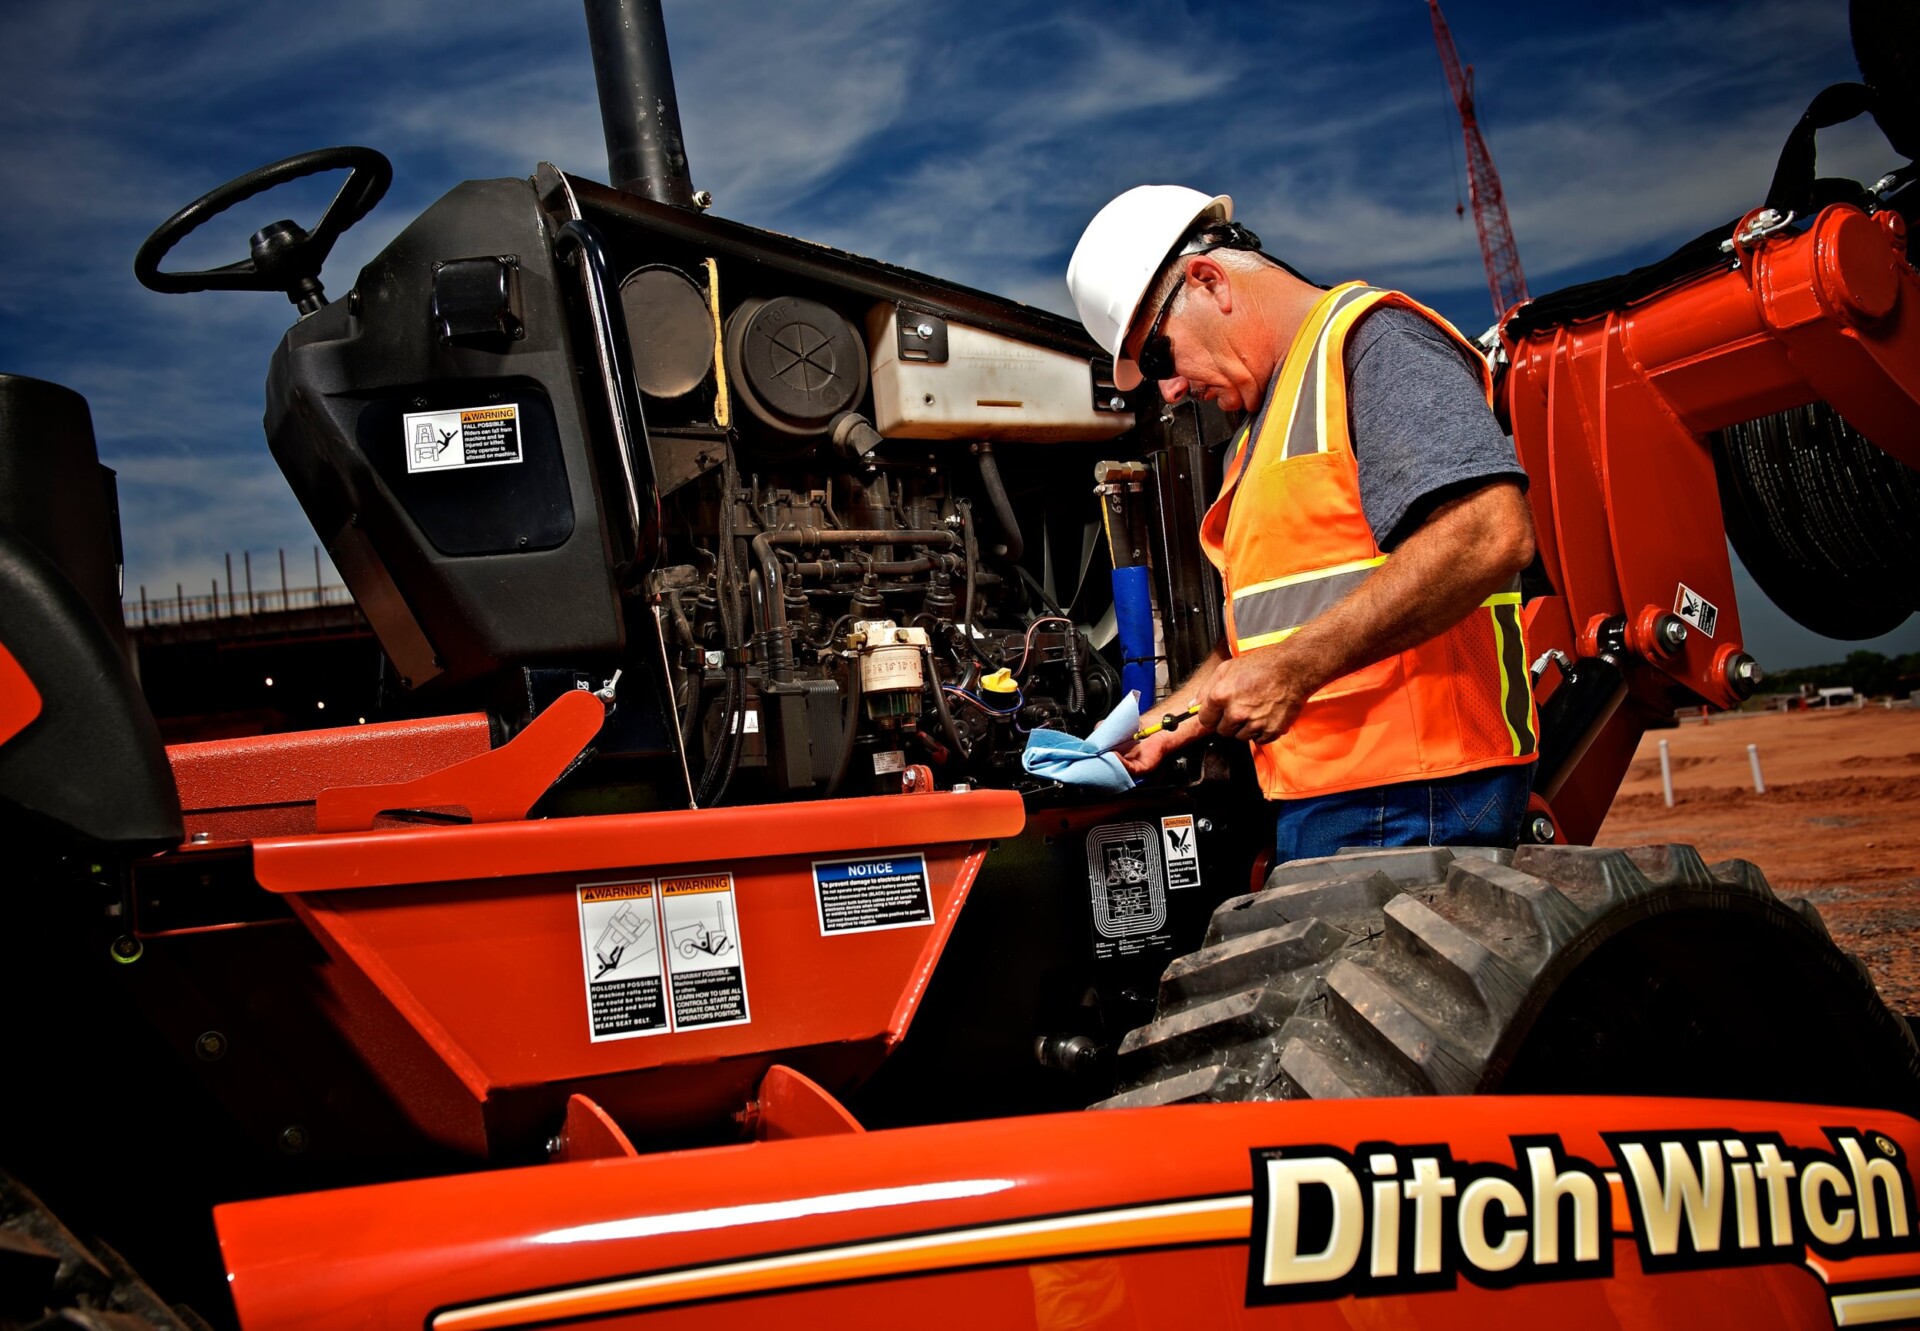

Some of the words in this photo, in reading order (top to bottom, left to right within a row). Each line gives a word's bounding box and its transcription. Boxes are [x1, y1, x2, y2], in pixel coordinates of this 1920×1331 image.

[763, 306, 788, 326] TOP
[472, 410, 513, 420] WARNING
[848, 862, 893, 876] NOTICE
[675, 878, 727, 891] WARNING
[595, 885, 648, 899] WARNING
[702, 969, 731, 977] POSSIBLE.
[591, 983, 625, 992] ROLLOVER
[627, 979, 661, 988] POSSIBLE.
[676, 1000, 708, 1008] CONTROLS.
[677, 1007, 703, 1015] OPERATE
[714, 1009, 741, 1018] POSITION.
[1262, 1145, 1600, 1287] Ditch
